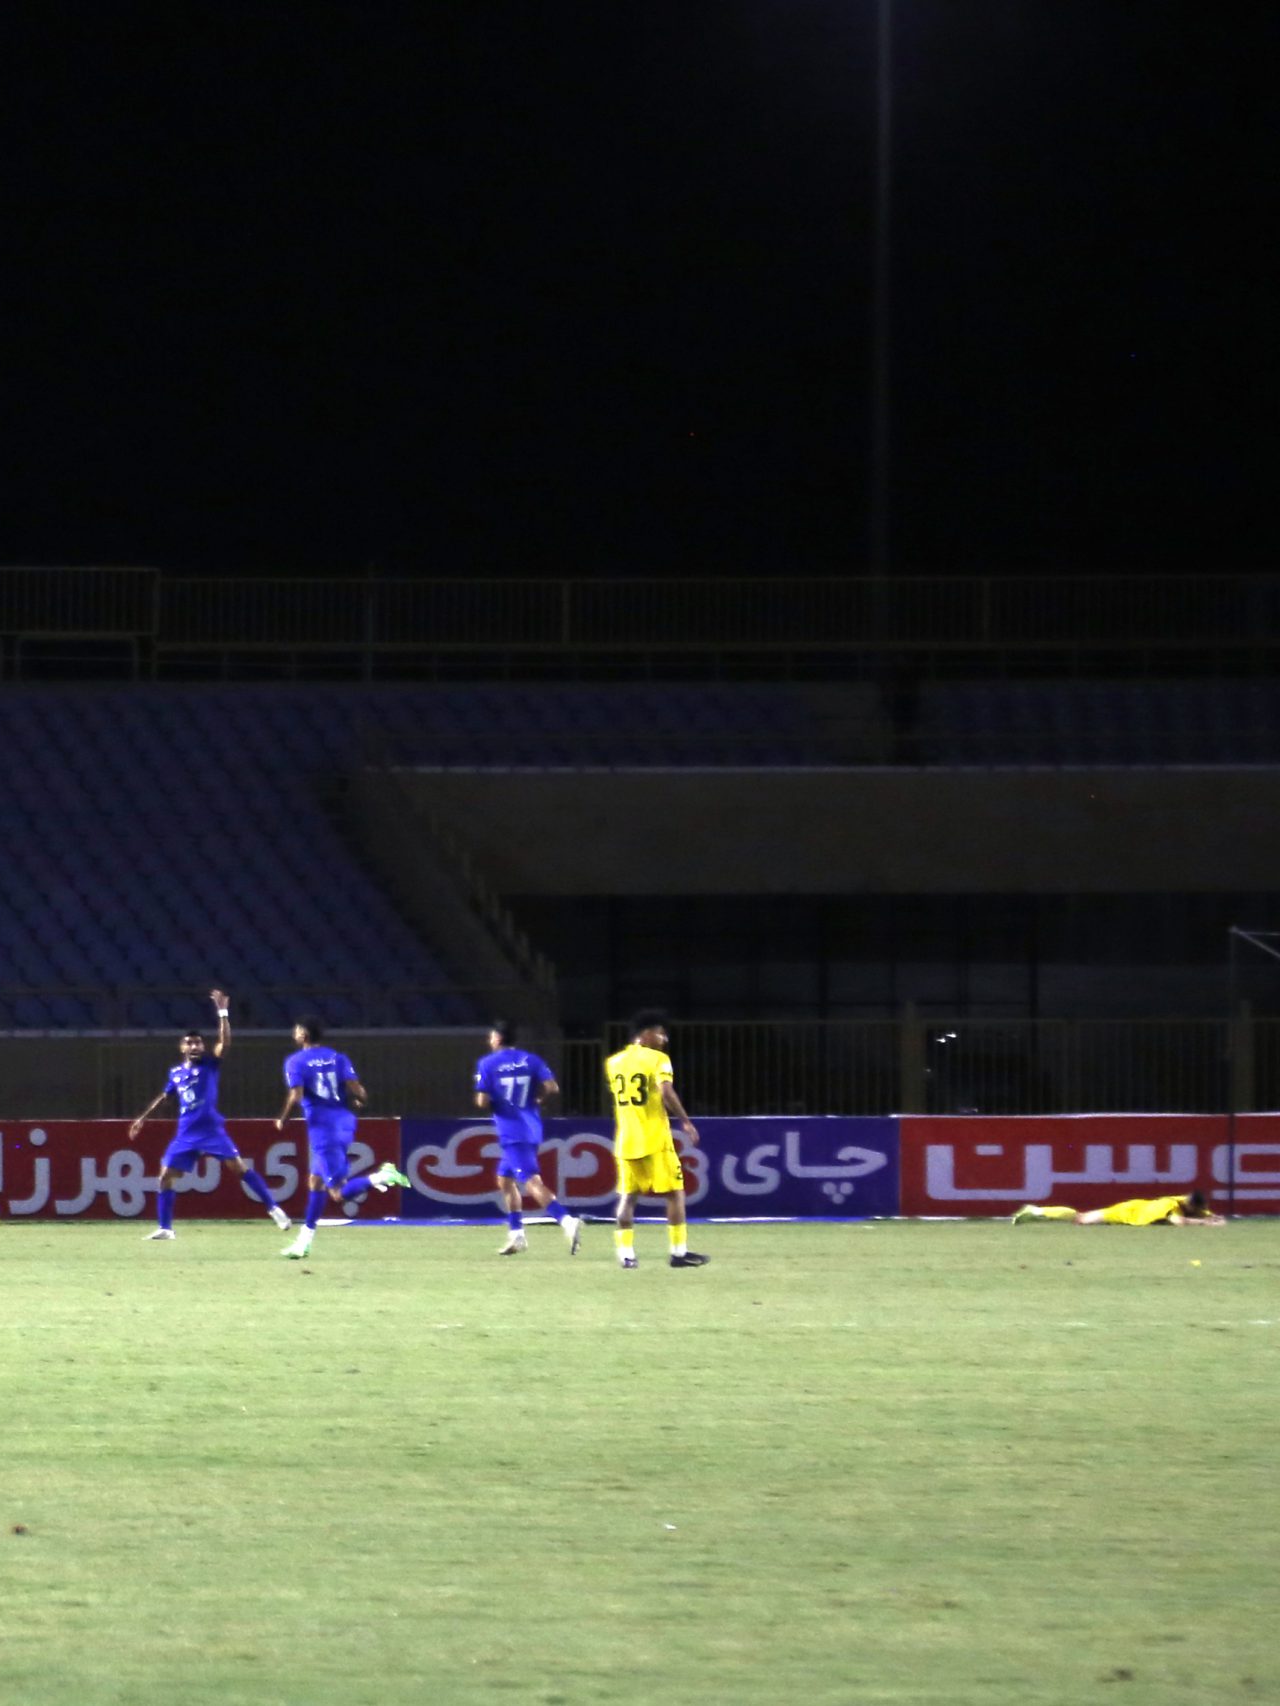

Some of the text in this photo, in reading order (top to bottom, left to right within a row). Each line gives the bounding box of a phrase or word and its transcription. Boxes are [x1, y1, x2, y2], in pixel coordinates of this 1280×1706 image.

[500, 1076, 531, 1108] 77
[615, 1073, 648, 1107] 23
[722, 1132, 888, 1204] چای
